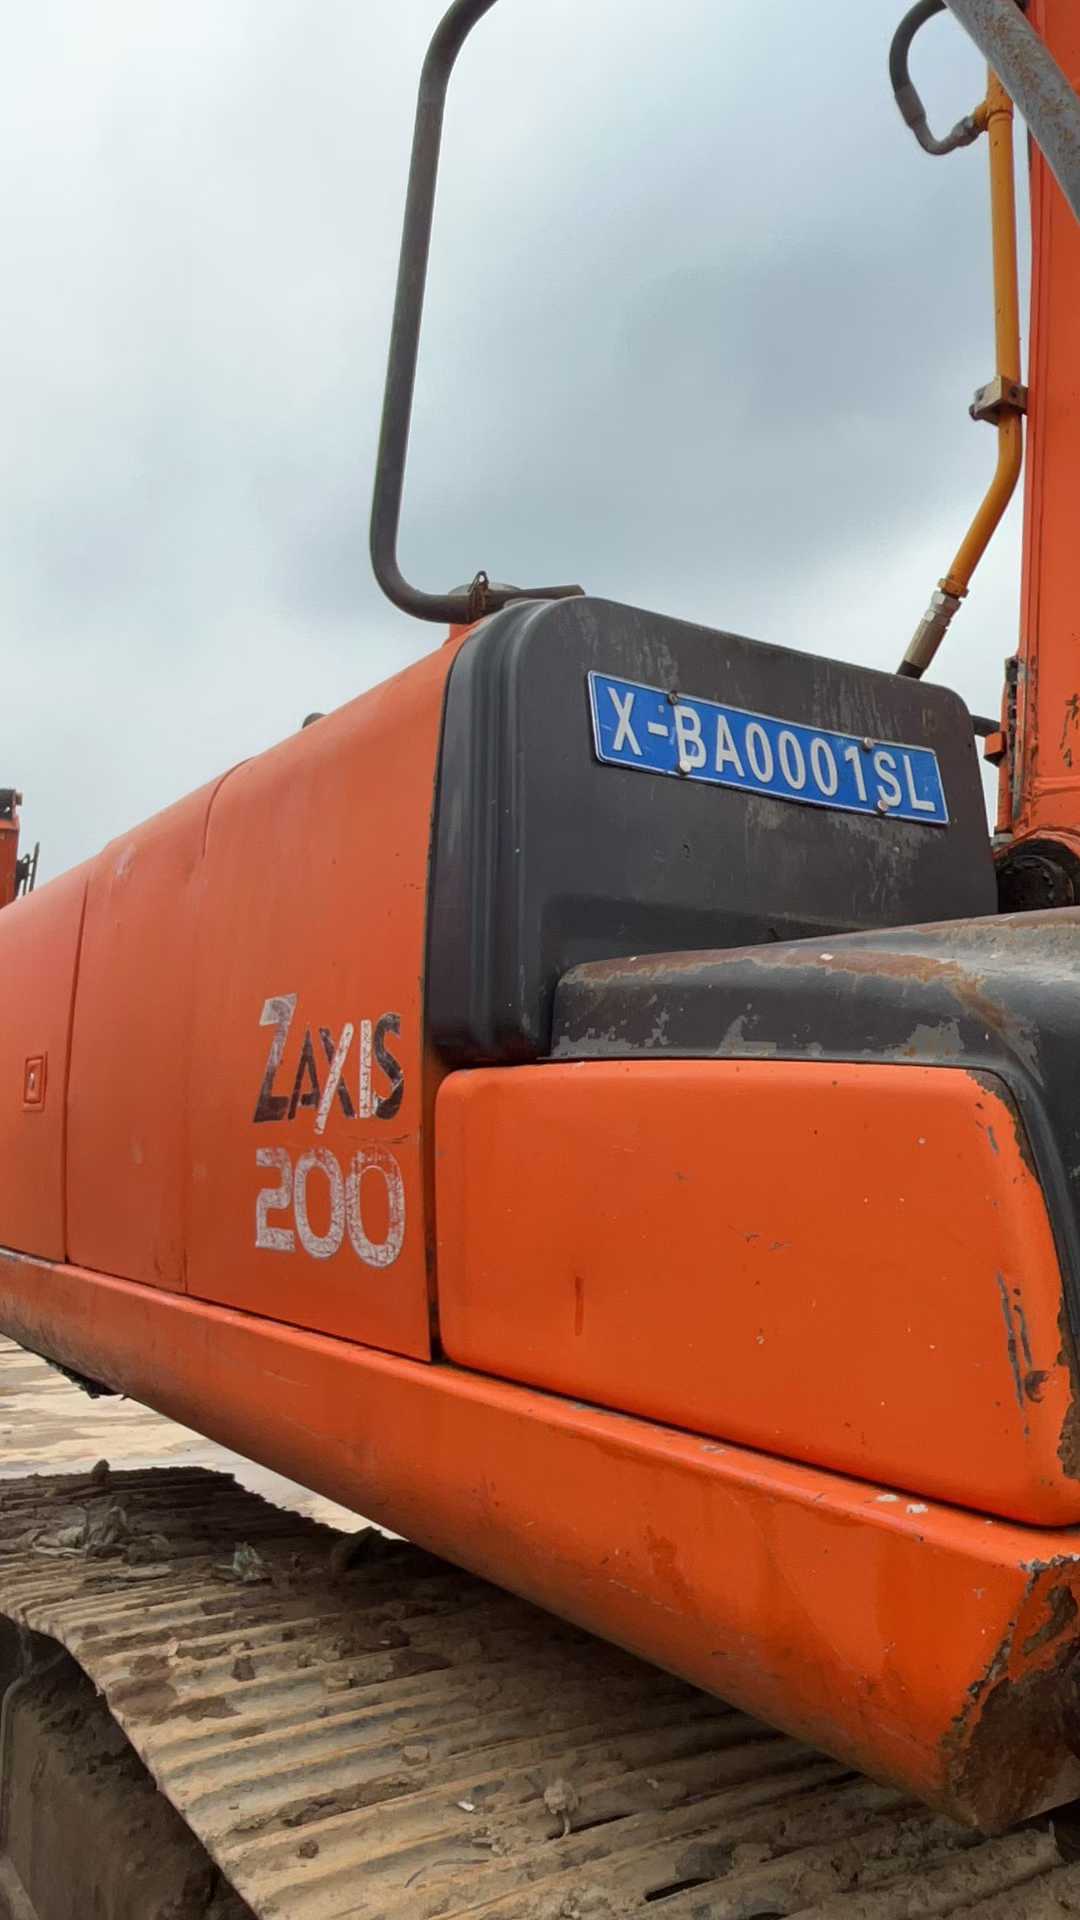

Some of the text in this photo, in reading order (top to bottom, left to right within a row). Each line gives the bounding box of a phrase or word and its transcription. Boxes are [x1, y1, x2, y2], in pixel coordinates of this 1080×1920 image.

[607, 686, 936, 813] X-BA0001SL
[253, 993, 404, 1135] ZAXIS
[255, 1146, 405, 1268] 200
